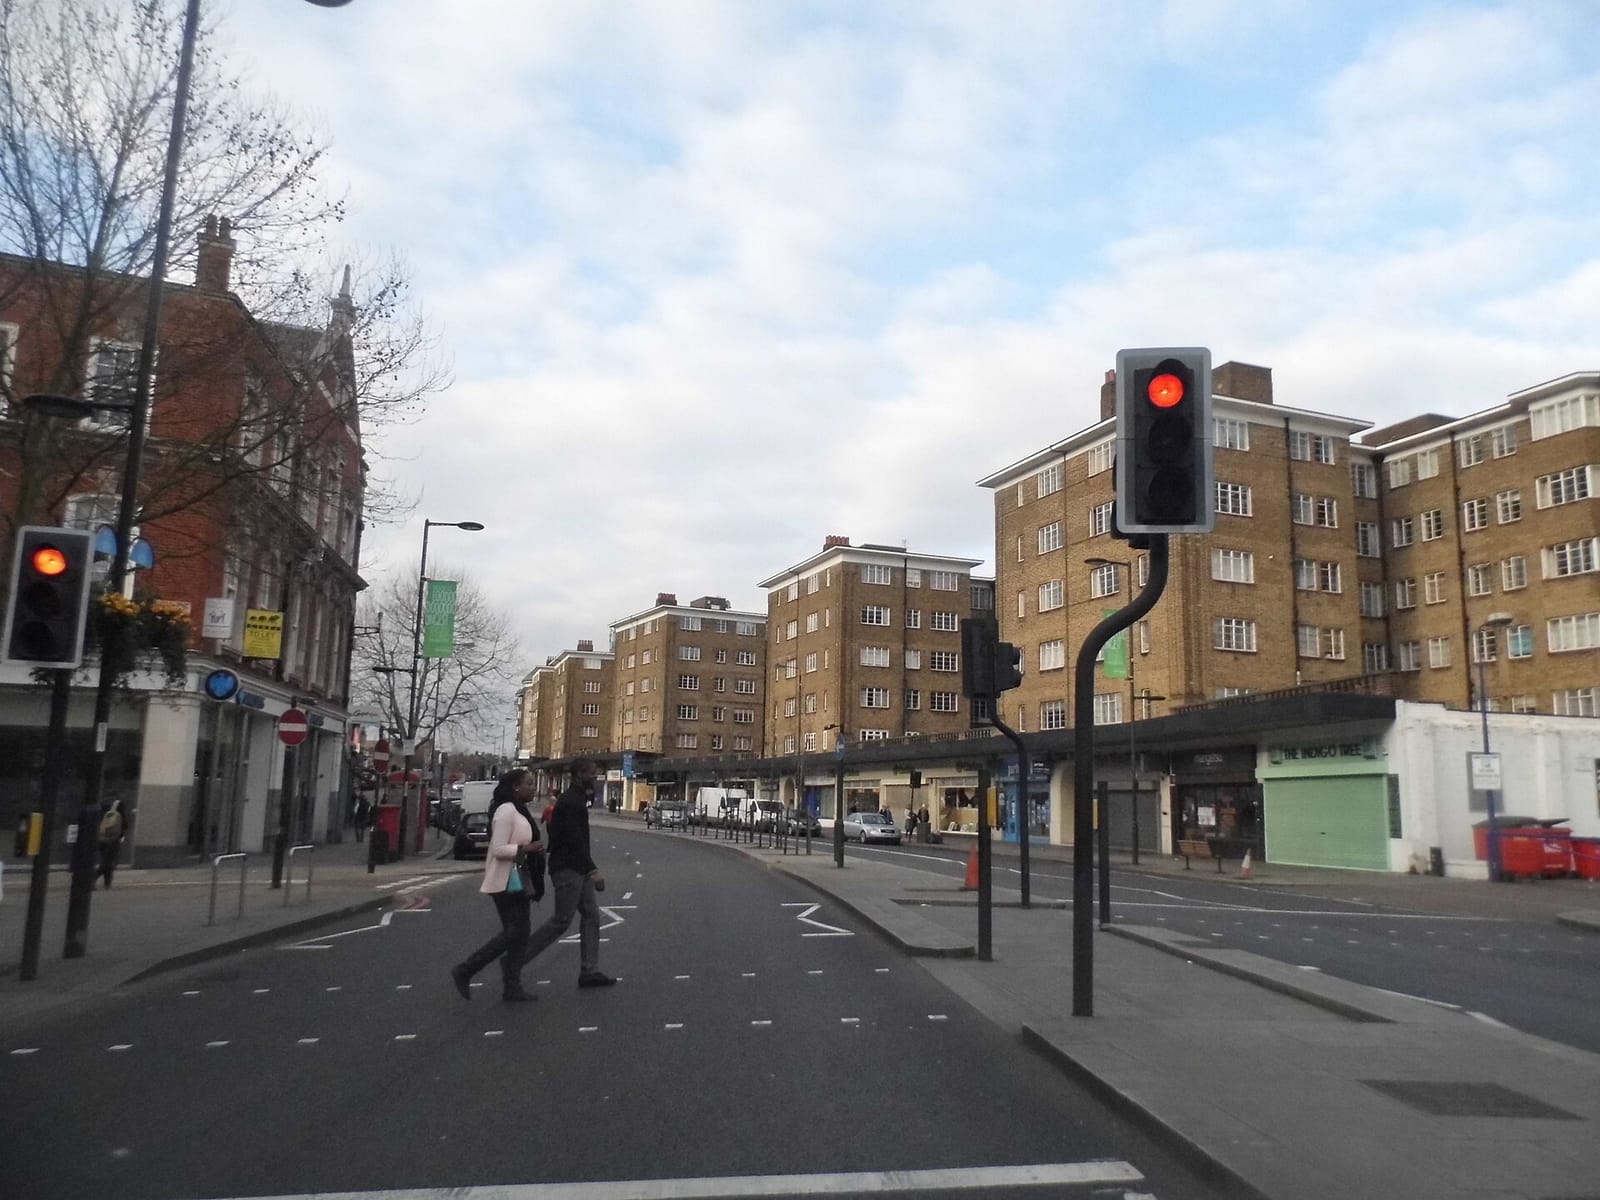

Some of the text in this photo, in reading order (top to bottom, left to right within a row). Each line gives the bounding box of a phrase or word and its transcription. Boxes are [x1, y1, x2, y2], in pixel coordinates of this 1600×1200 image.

[1283, 743, 1362, 760] THE INDIGO TREE
